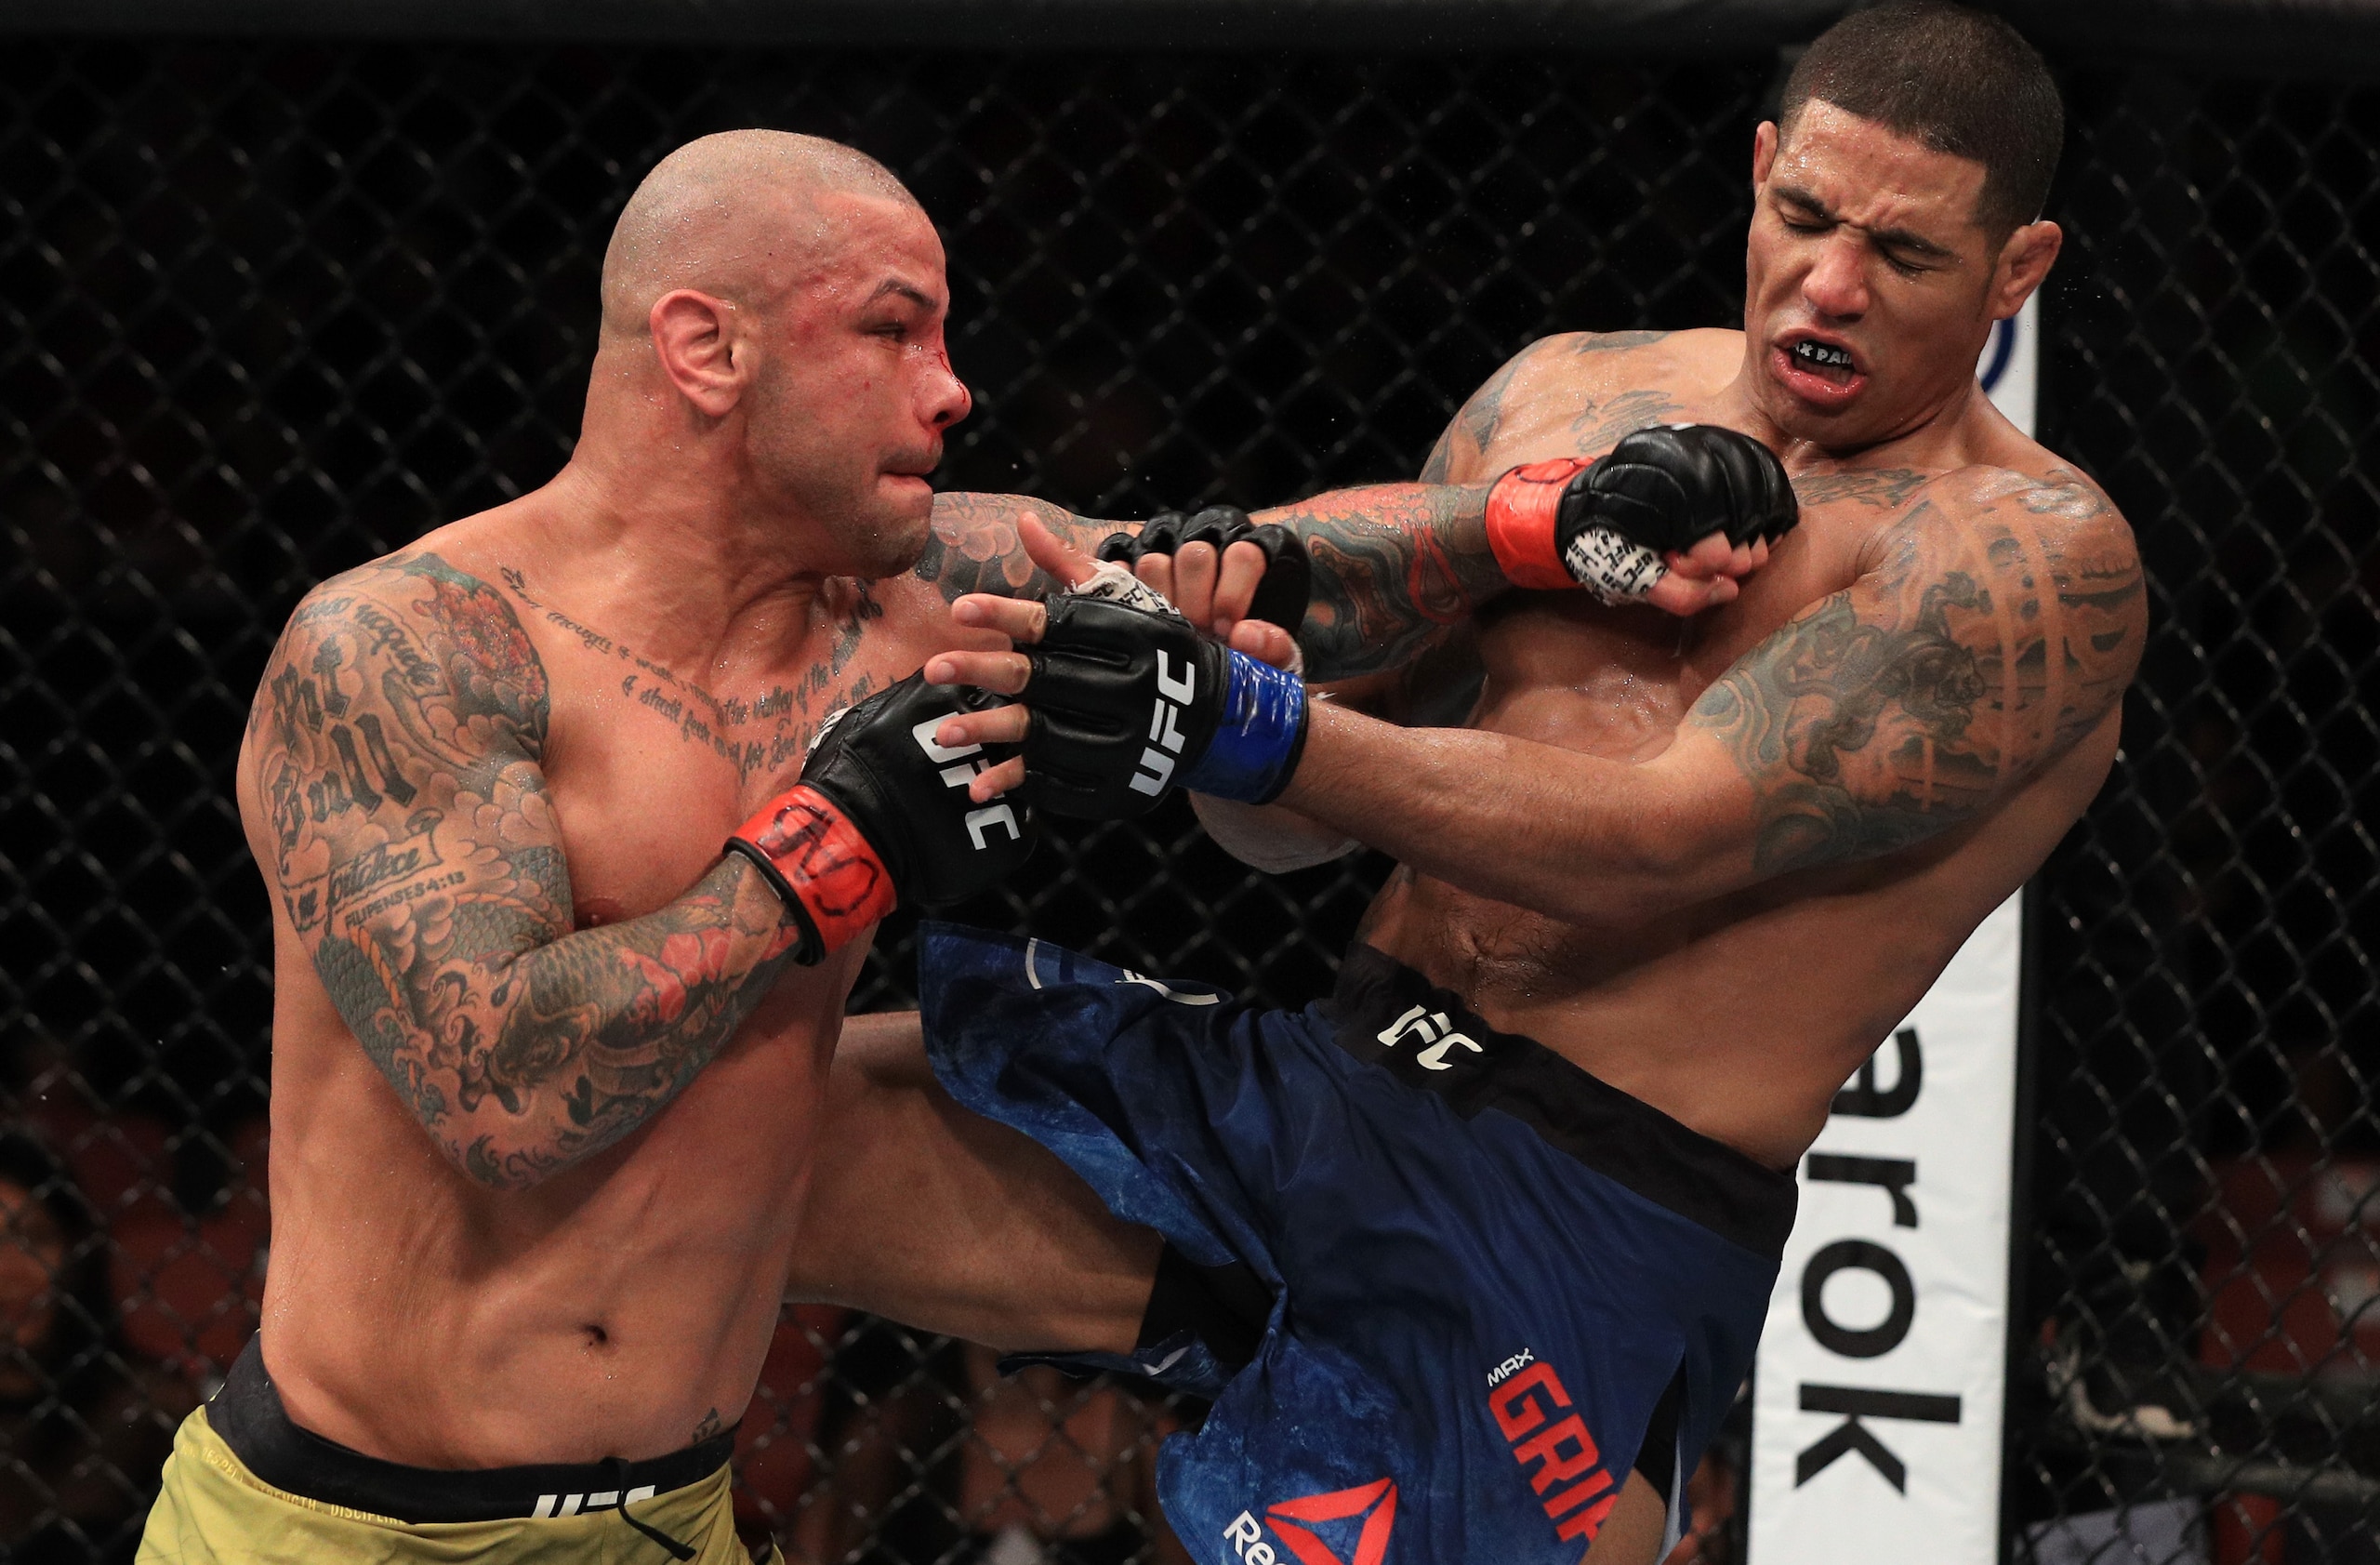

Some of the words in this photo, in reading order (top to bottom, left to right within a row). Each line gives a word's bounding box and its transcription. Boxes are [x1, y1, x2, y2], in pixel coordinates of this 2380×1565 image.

[1129, 648, 1196, 798] UFC
[1488, 1347, 1535, 1386] MAX
[1223, 1509, 1289, 1565] Re
